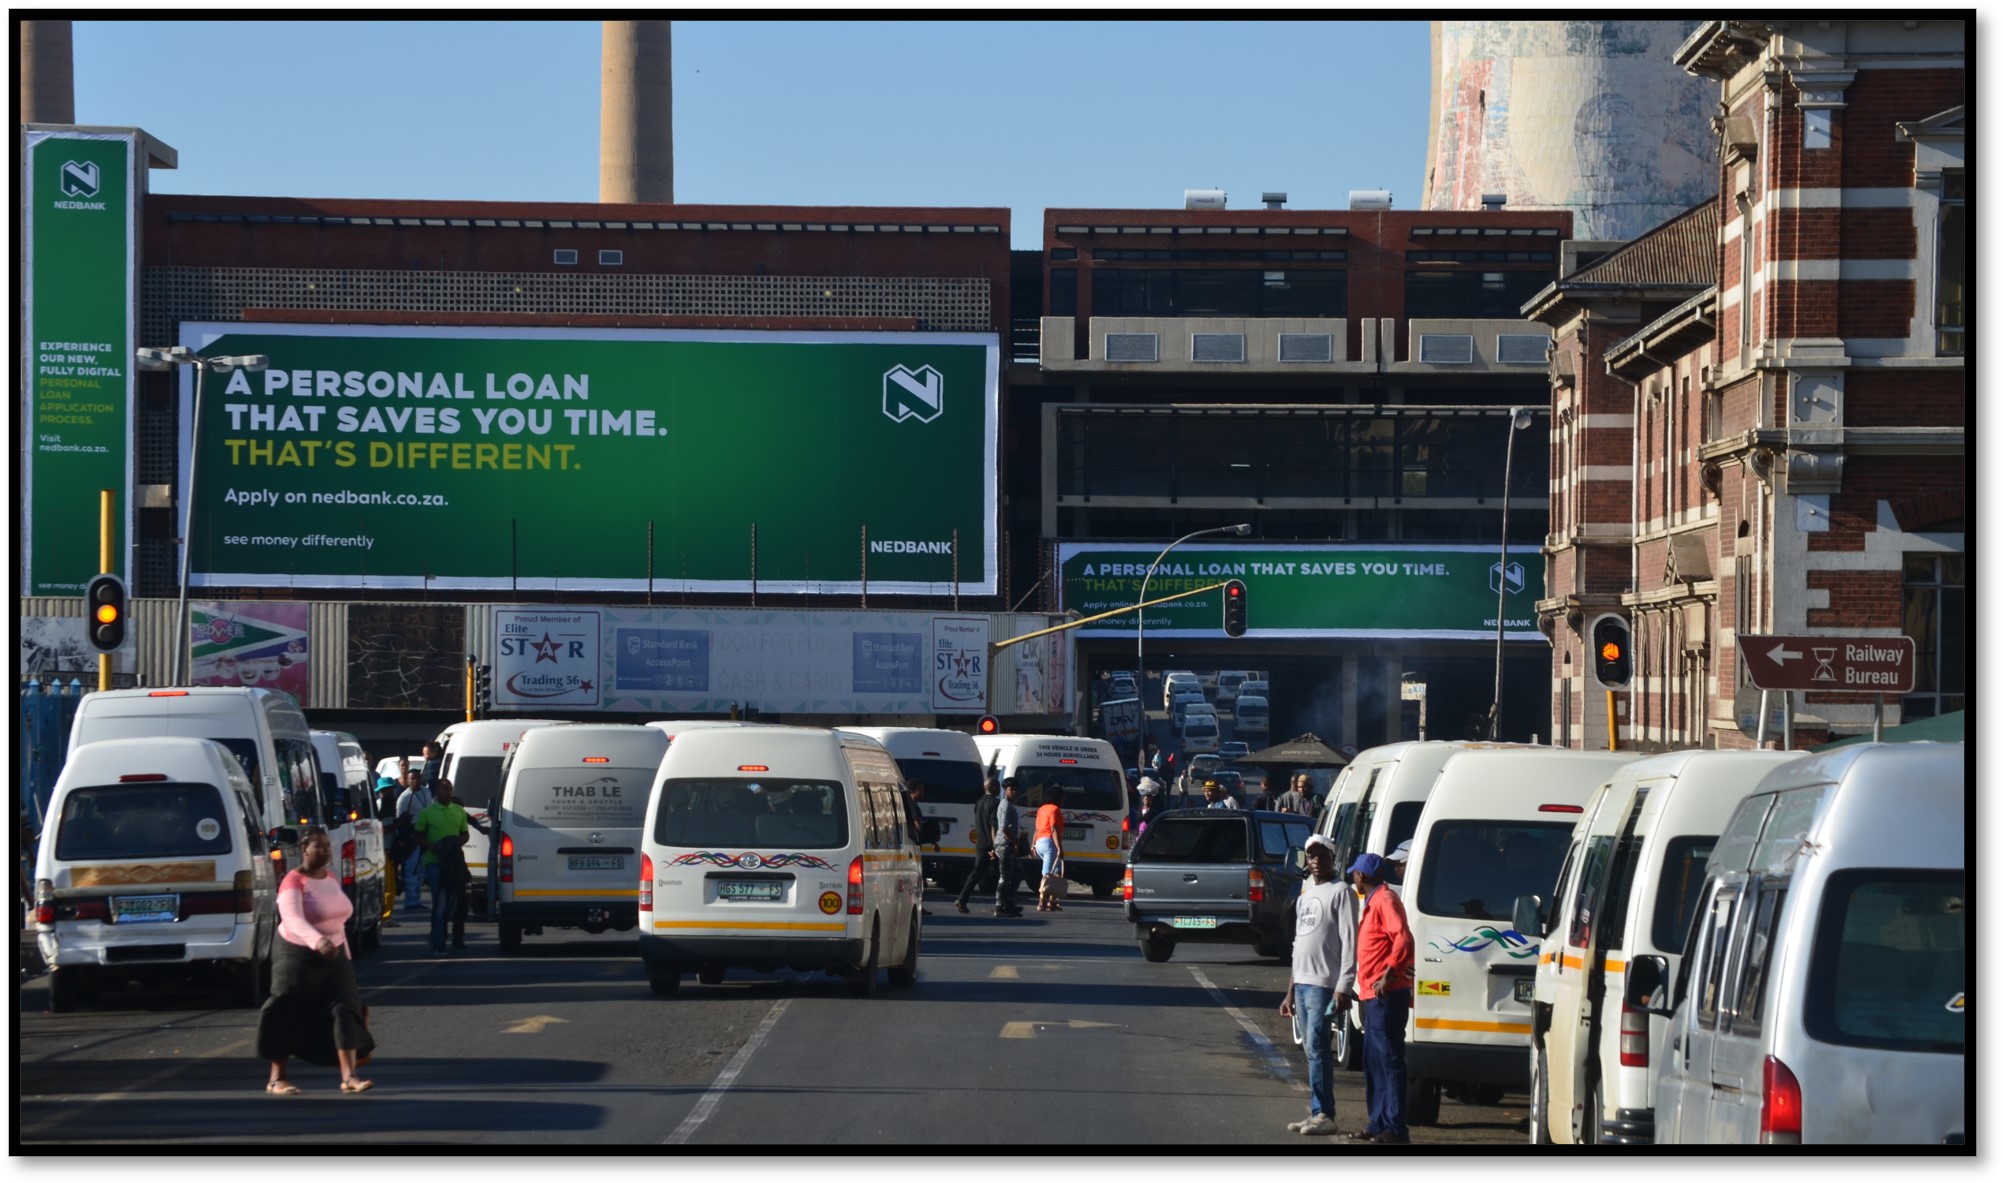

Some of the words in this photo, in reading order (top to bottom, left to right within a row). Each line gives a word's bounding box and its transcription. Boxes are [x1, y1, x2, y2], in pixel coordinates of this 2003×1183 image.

[54, 201, 106, 210] NEDBANK
[40, 342, 112, 352] EXPERIENCE
[40, 354, 65, 363] OUR
[40, 366, 75, 375] FULLY
[77, 367, 122, 377] DIGITAL
[40, 378, 101, 388] PERSONAL
[224, 369, 252, 395] A
[264, 369, 475, 400] PERSONAL
[486, 372, 589, 400] LOAN
[40, 391, 71, 399] LOAN
[40, 403, 114, 413] APPLICATION
[40, 415, 95, 424] PROCESS.
[224, 403, 326, 431] THAT
[337, 406, 460, 434] SAVES
[472, 408, 553, 436] YOU
[564, 409, 668, 437] TIME.
[40, 434, 61, 442] Visit
[40, 444, 109, 452] nedbank.co.za.
[224, 438, 356, 467] THAT'S
[370, 442, 581, 470] DIFFERENT.
[224, 487, 279, 508] Apply
[284, 492, 307, 503] on
[312, 489, 449, 507] nedbank.co.za.
[223, 535, 248, 545] see
[251, 535, 298, 549] money
[302, 533, 374, 550] differently
[870, 540, 952, 554] NEDBANK
[1083, 563, 1095, 575] A
[1100, 563, 1194, 576] PERSONAL
[1199, 563, 1246, 576] LOAN
[1251, 563, 1296, 575] THAT
[1301, 563, 1356, 575] SAVES
[1361, 563, 1398, 576] YOU
[1403, 563, 1450, 576] TIME.
[1083, 578, 1141, 591] THAT'S
[1083, 601, 1107, 609] Apply
[1147, 600, 1209, 608] edbank.co.za.
[514, 615, 538, 623] Proud
[1129, 617, 1172, 625] diferently
[1484, 619, 1531, 627] NEBANK
[198, 623, 245, 638] POWER
[505, 624, 528, 634] Elite
[501, 636, 585, 658] STAR
[642, 639, 678, 649] Standard
[680, 640, 698, 649] Bank
[939, 638, 953, 648] Elite
[1845, 644, 1904, 666] Railway
[937, 653, 981, 673] STAR
[1845, 666, 1898, 685] Bureau
[521, 674, 563, 688] Trading
[566, 675, 580, 685] 56
[718, 670, 766, 691] CASH
[789, 671, 845, 692] CARRY
[948, 680, 971, 692] Trading
[972, 681, 979, 689] 56
[1063, 752, 1099, 760] SURVEILLANCE
[719, 883, 736, 894] HGS
[738, 883, 755, 894] 577
[769, 883, 781, 894] FS
[823, 898, 837, 908] 100
